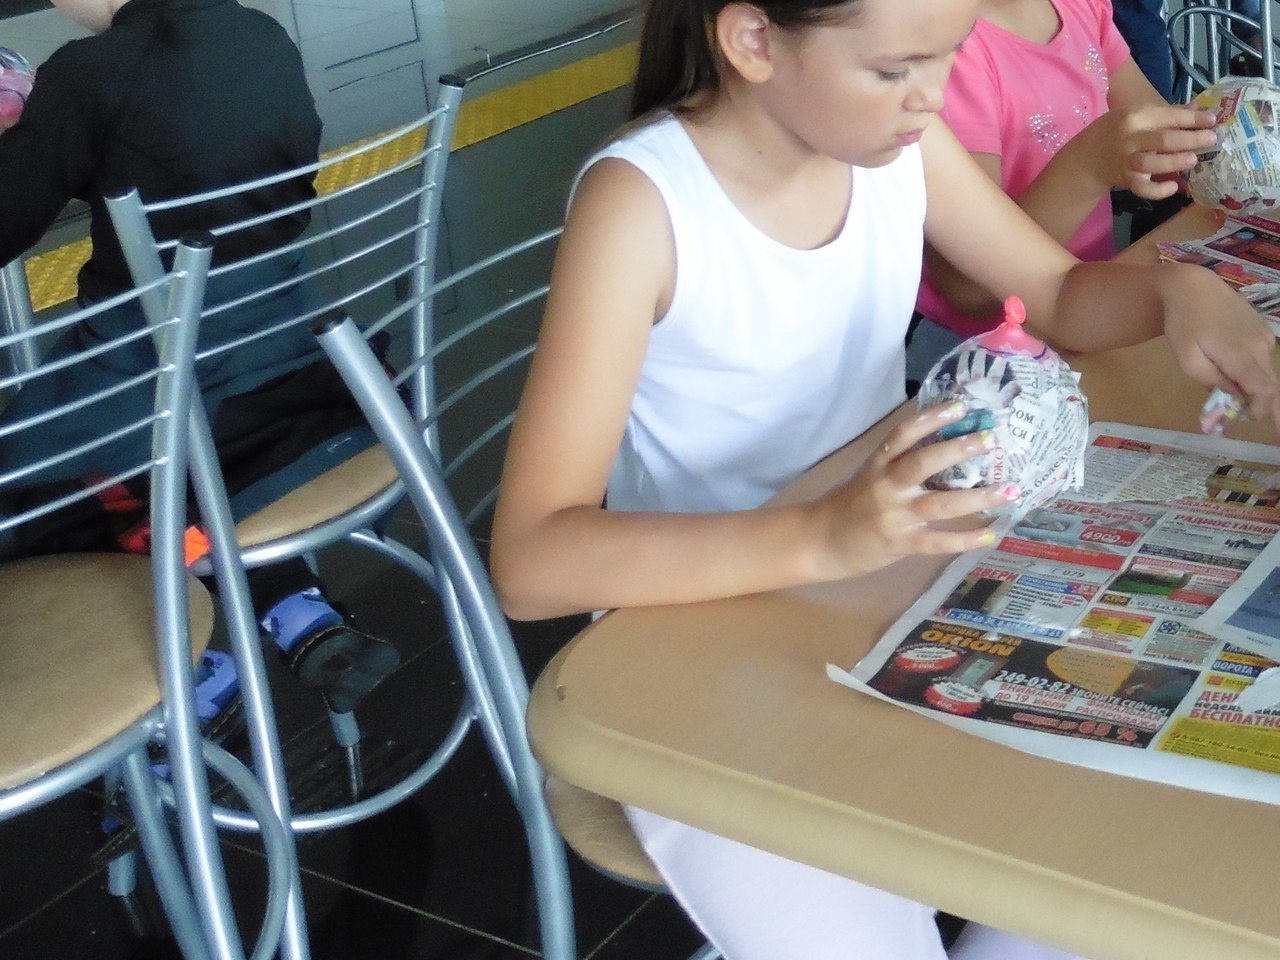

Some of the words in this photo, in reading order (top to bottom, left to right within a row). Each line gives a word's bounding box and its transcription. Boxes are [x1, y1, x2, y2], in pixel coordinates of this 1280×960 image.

[1054, 501, 1152, 523] УПЕРцена!
[968, 566, 1019, 583] ДВЕРИ
[921, 629, 1016, 657] ORION
[1213, 660, 1254, 675] ВОРОТА
[995, 670, 1071, 696] 249-02-82
[1199, 690, 1239, 704] ДЕН
